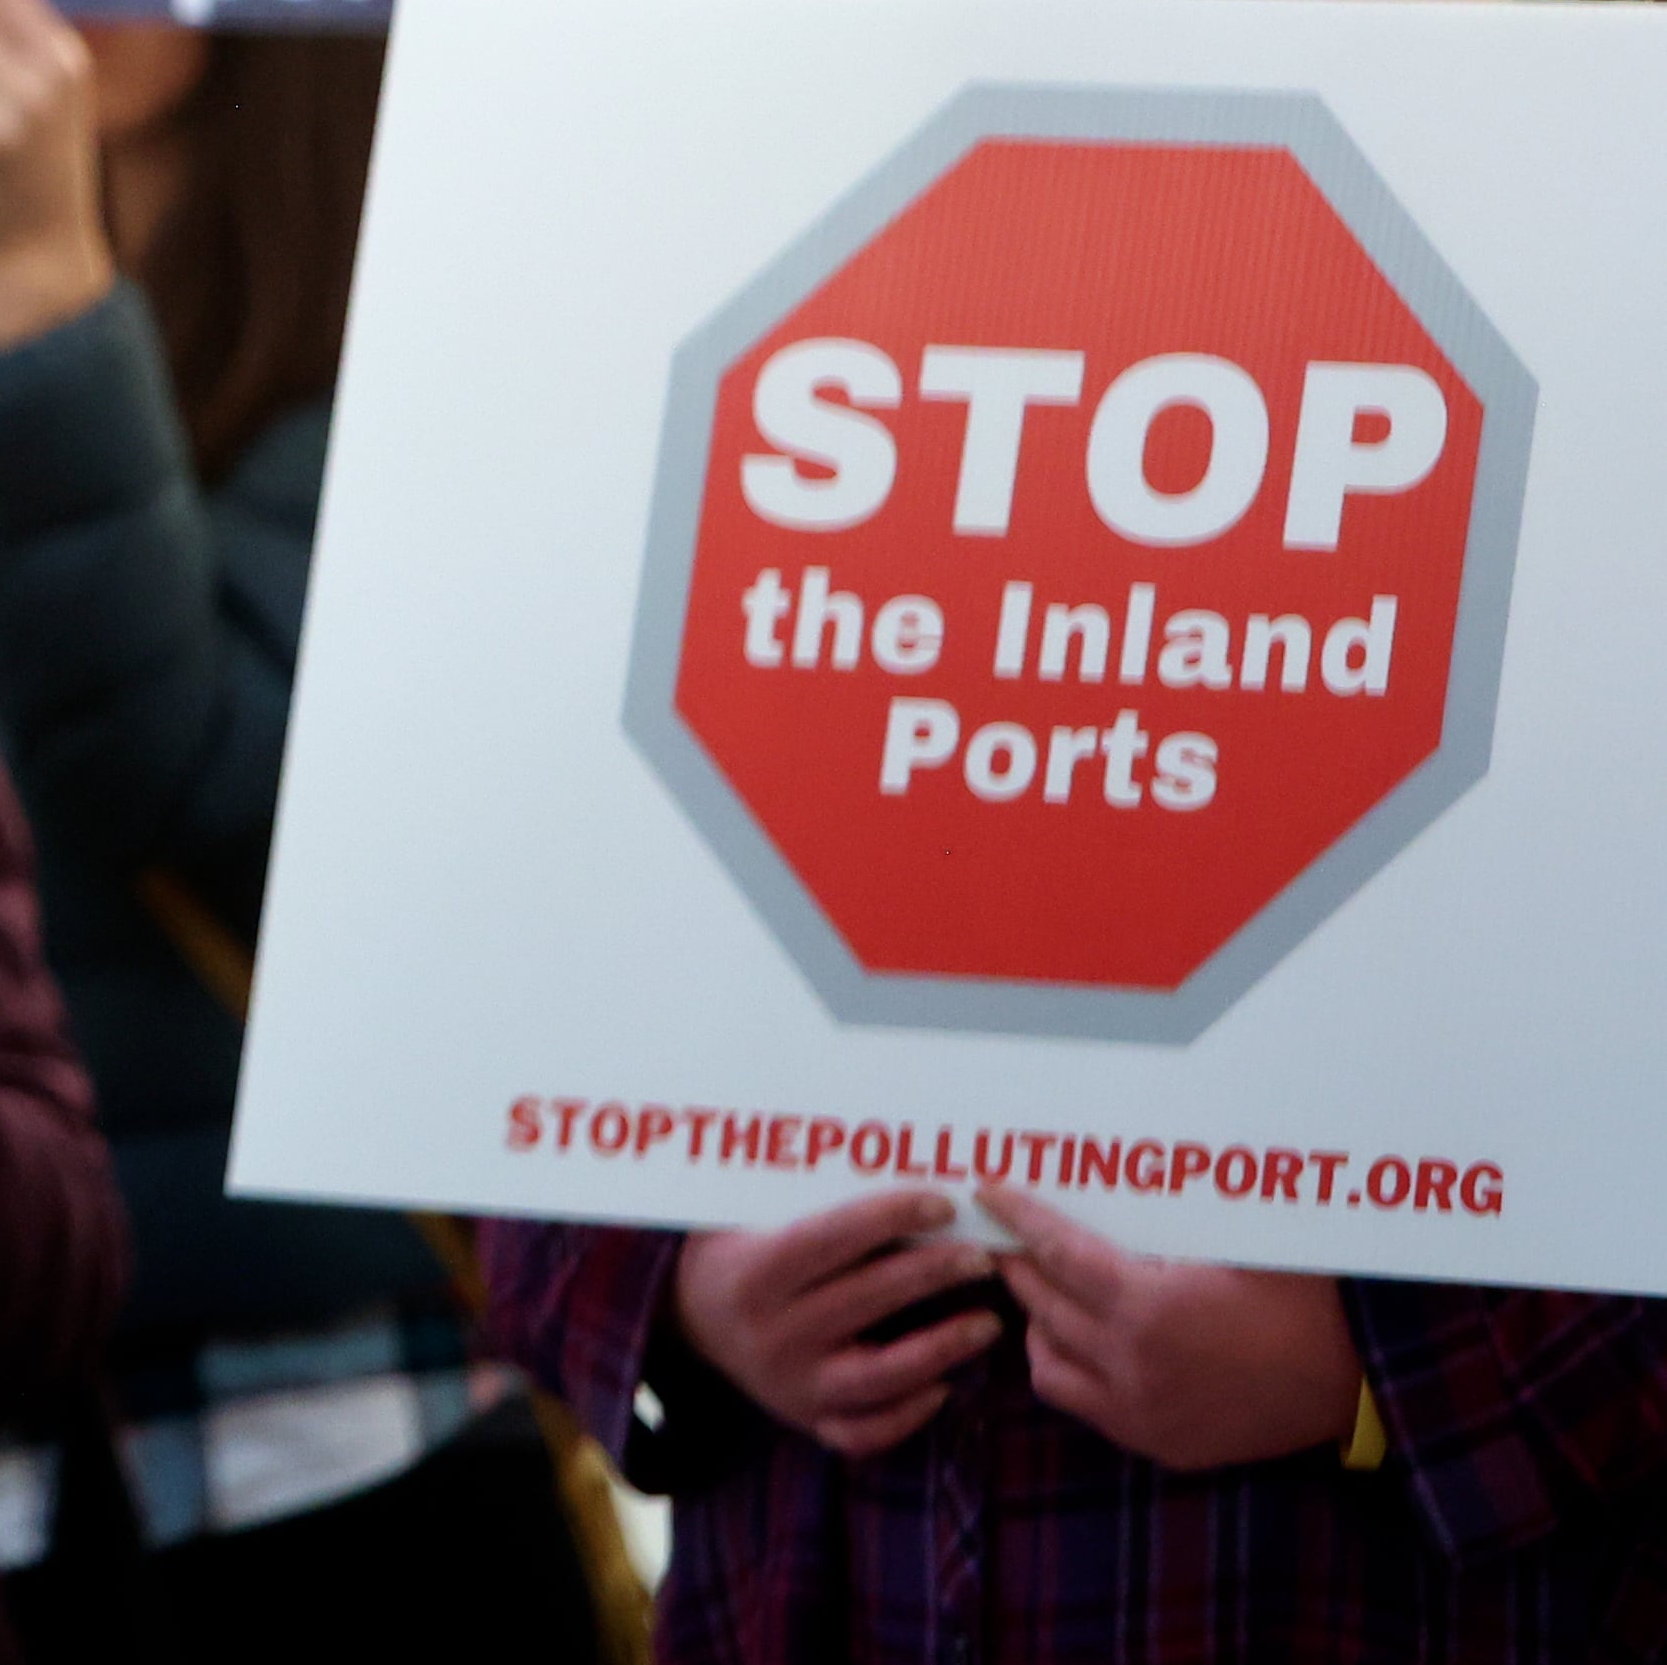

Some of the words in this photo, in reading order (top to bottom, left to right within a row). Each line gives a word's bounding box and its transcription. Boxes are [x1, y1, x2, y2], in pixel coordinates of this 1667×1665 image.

[742, 340, 1445, 553] STOP
[742, 567, 945, 675] the
[995, 583, 1399, 697] Inland
[879, 697, 1222, 813] Ports
[505, 1095, 1507, 1220] STOPTHEPOLLUTINGPORT.ORG
